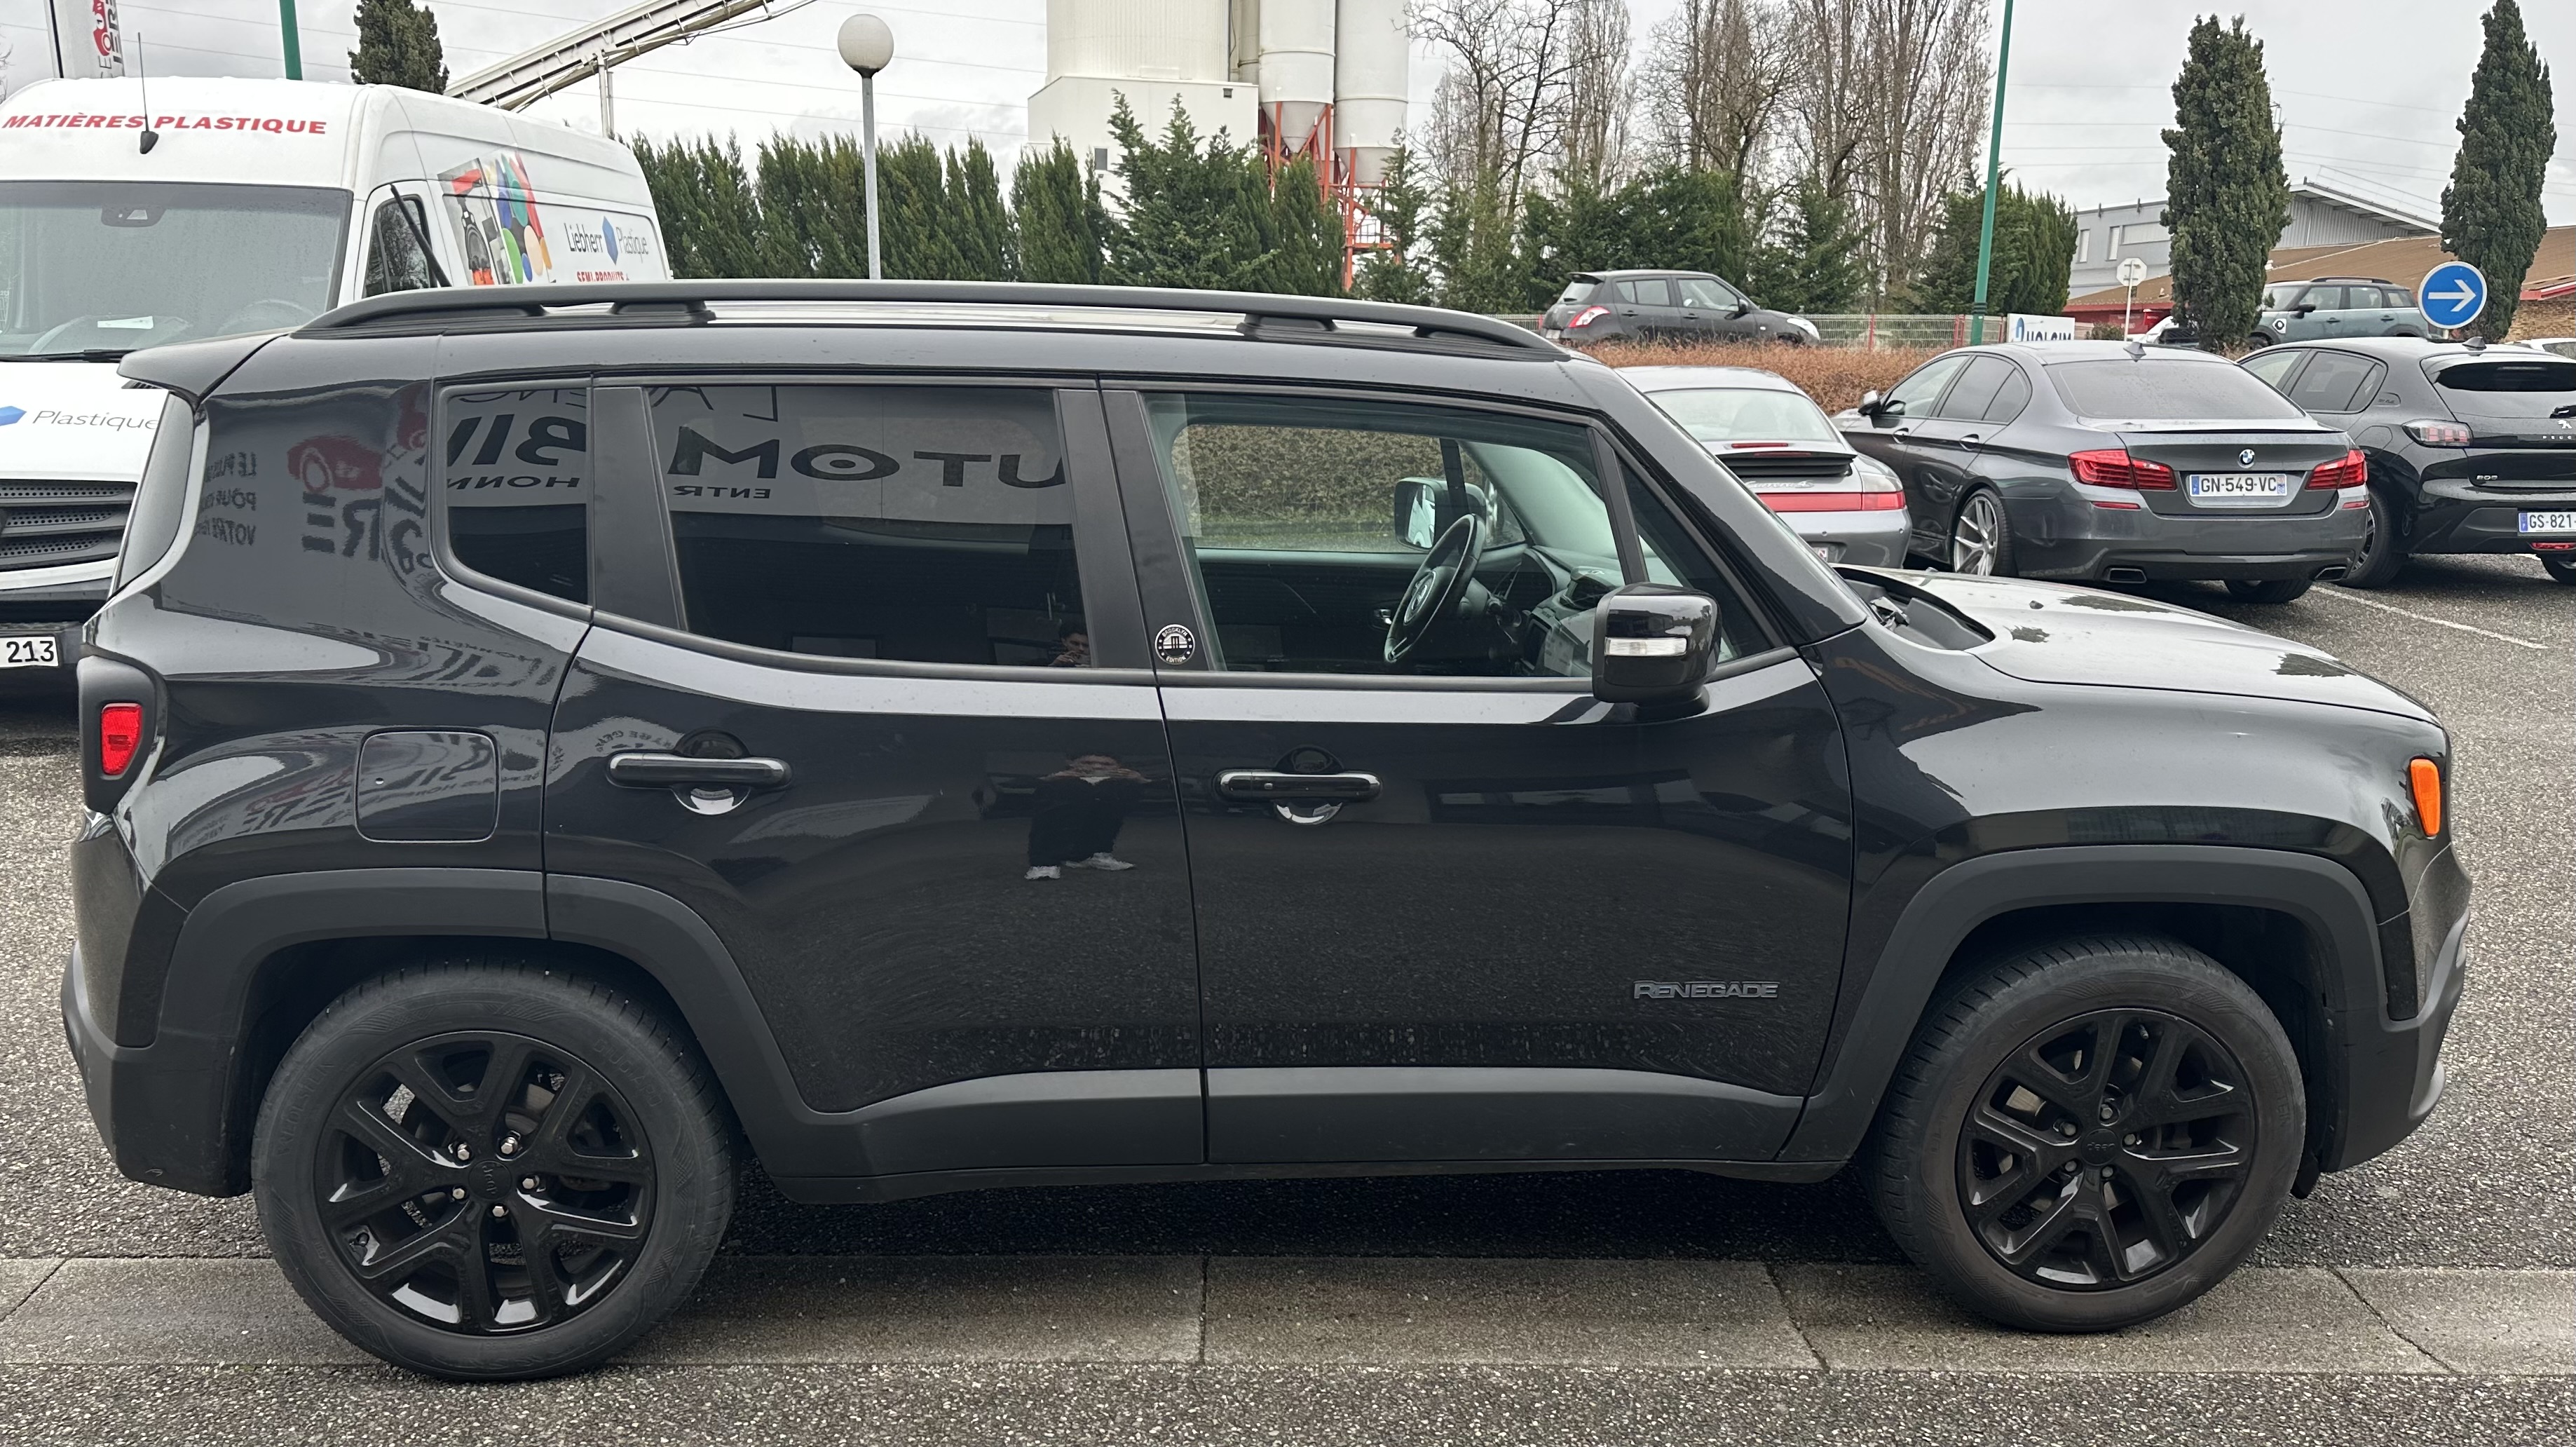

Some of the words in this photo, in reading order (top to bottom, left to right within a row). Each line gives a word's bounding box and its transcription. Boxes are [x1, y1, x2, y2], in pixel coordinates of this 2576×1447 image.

[1, 112, 147, 128] MATIÈRES
[154, 116, 327, 135] PLASTIQUE
[563, 222, 604, 253] Liebherr
[615, 226, 649, 264] Plastique
[32, 410, 159, 432] Plastique
[2201, 477, 2277, 492] GN-549-VC
[6, 640, 55, 663] 213
[1166, 655, 1187, 663] EDITION
[1633, 980, 1780, 999] RENEGADE
